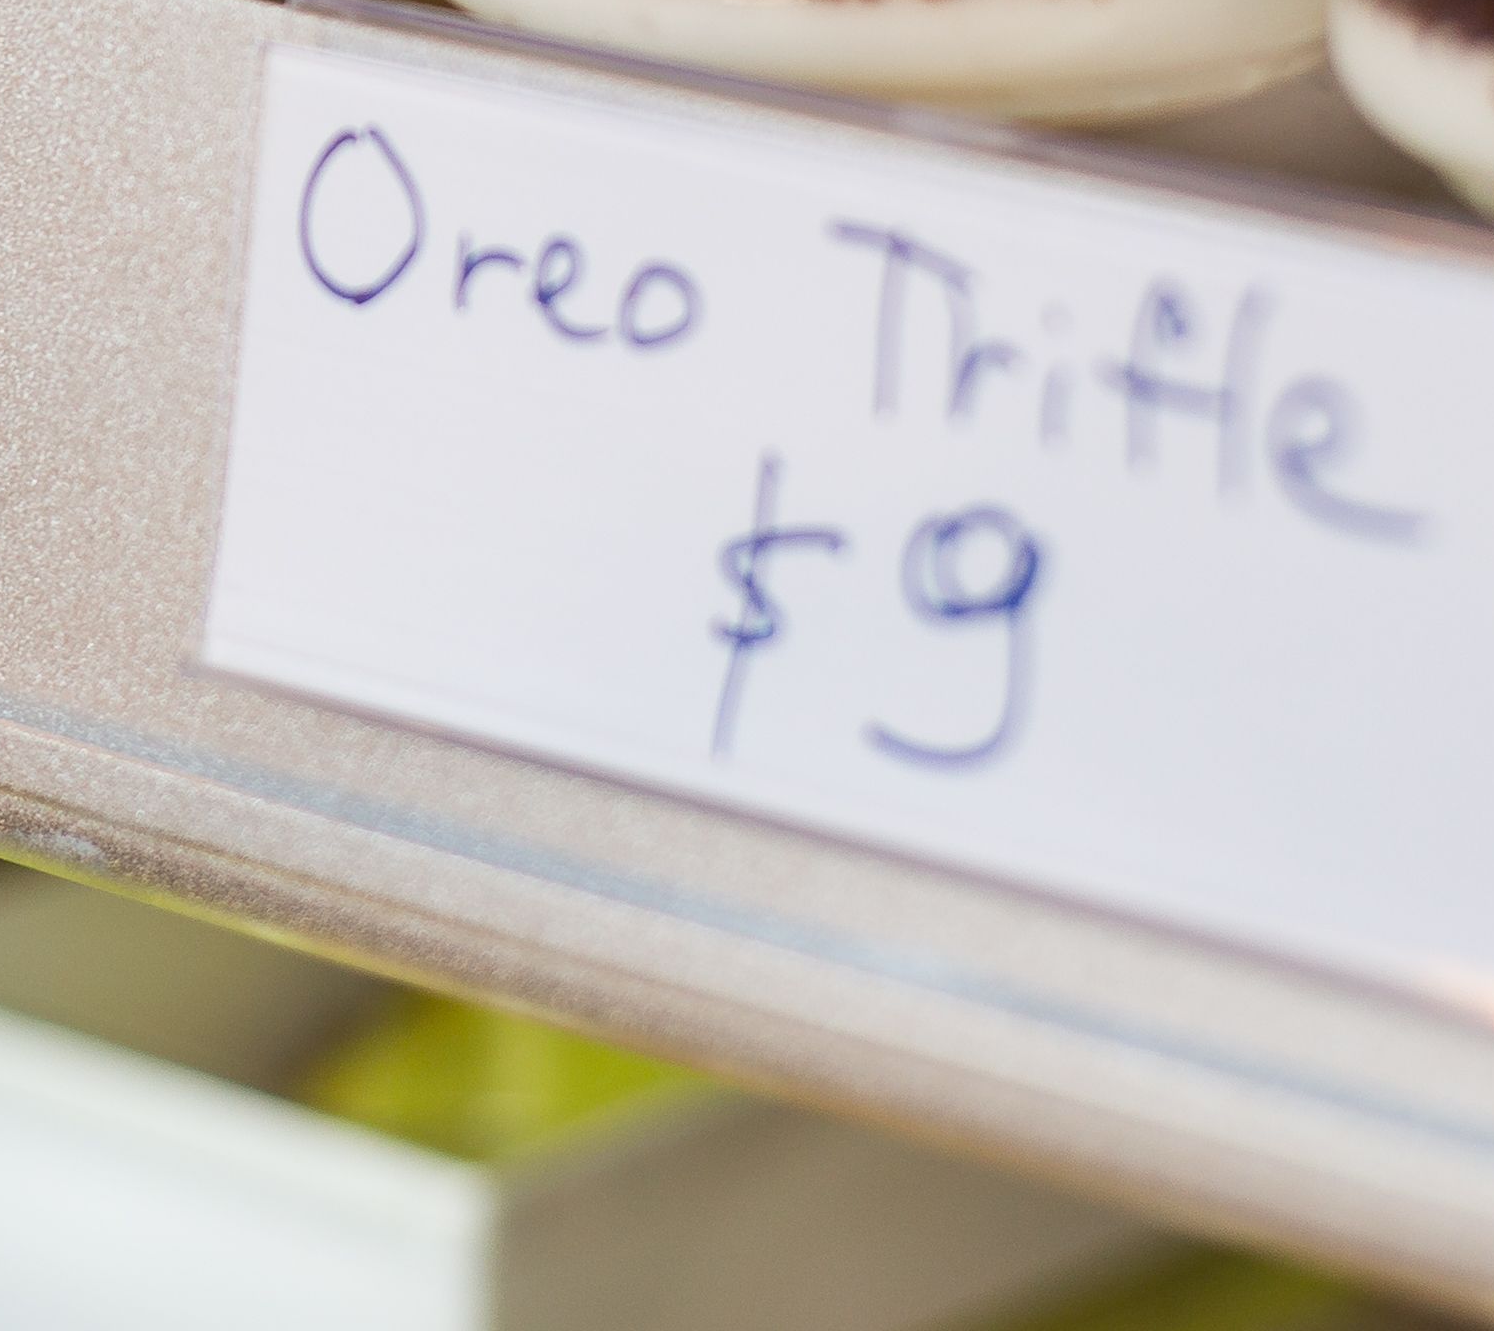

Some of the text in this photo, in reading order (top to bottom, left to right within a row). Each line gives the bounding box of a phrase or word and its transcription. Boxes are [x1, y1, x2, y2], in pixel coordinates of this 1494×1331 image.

[295, 123, 1433, 543] Oreo Trifle
[707, 450, 1050, 775] $9
